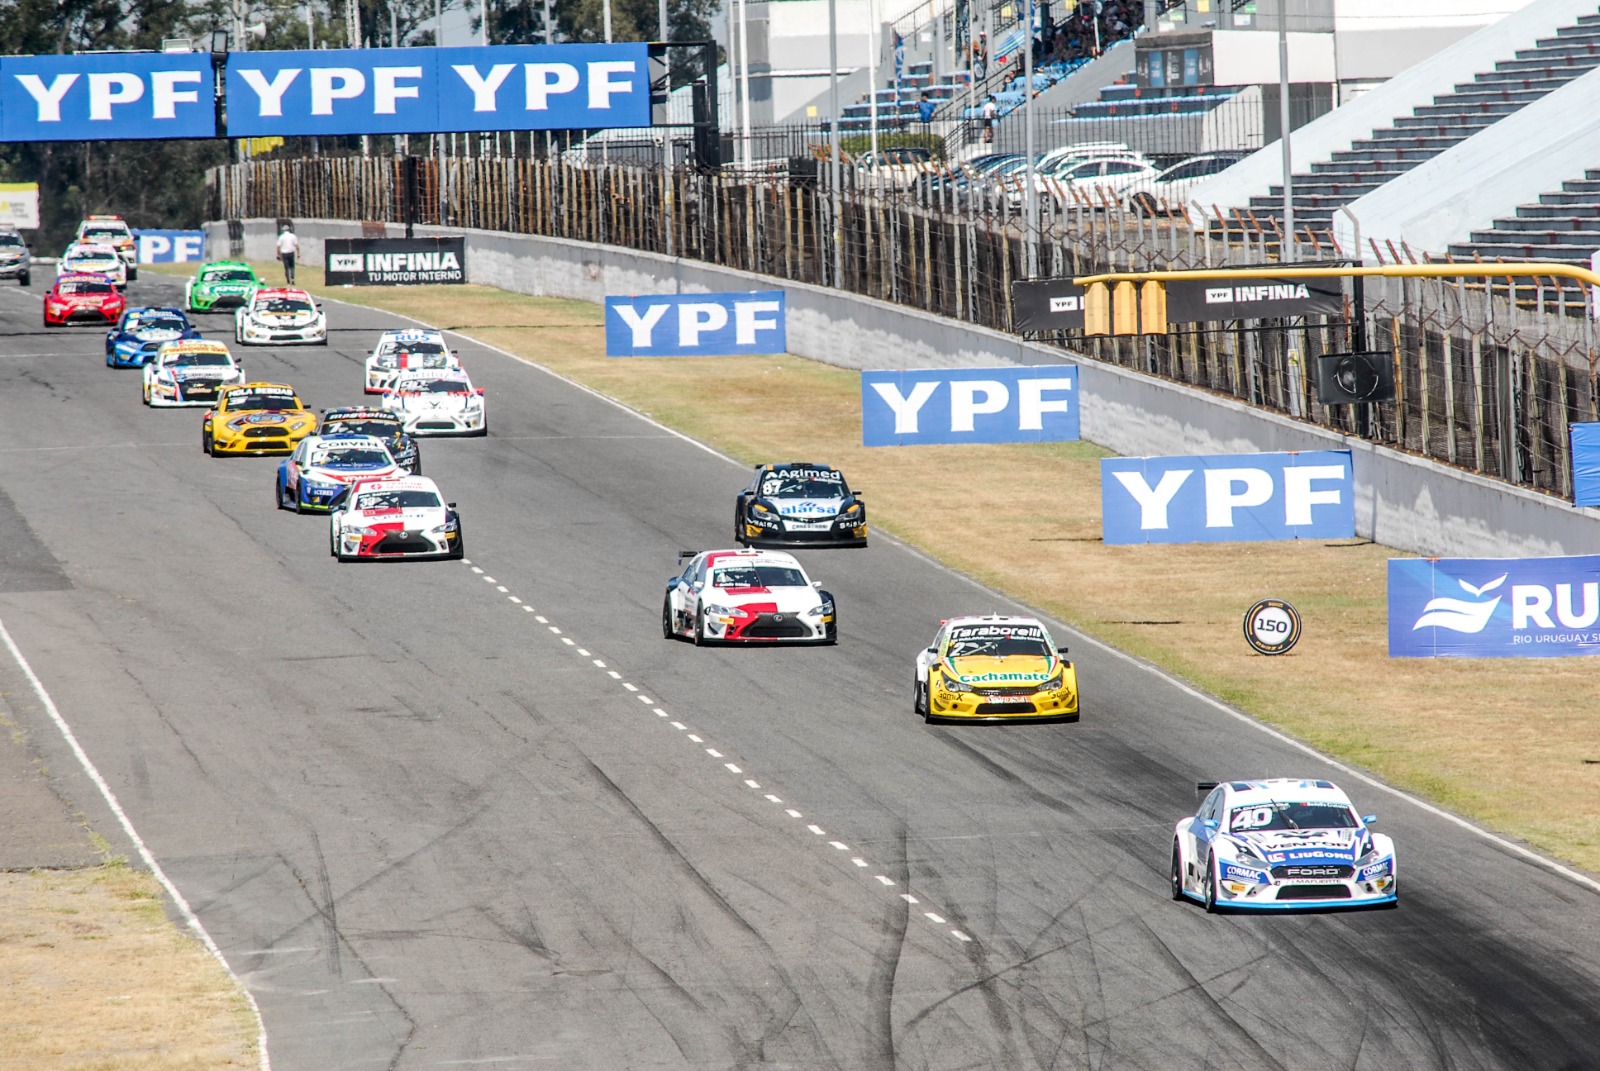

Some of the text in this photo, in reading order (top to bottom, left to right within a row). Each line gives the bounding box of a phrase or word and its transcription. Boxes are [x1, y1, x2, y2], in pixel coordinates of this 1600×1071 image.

[15, 71, 202, 122] YPF
[236, 61, 636, 117] YPF YPF
[139, 235, 202, 264] PF
[336, 252, 461, 272] YPF INFINIA
[368, 270, 462, 282] TU MOTOR INTERNO
[1235, 283, 1310, 303] INFINIA
[612, 301, 780, 348] YPF
[395, 334, 430, 342] RUS
[870, 378, 1072, 434] YPF
[316, 441, 378, 450] CORVEN
[778, 468, 841, 480] Agimed
[762, 480, 784, 495] 87
[1112, 465, 1345, 530] YPF
[780, 504, 837, 515] alarsa
[1512, 582, 1599, 629] RU
[952, 625, 1042, 639] Taraborelli
[1256, 618, 1288, 633] 150
[1513, 635, 1532, 644] RIO
[1535, 633, 1589, 643] URUGUAY
[950, 641, 966, 657] 2
[959, 672, 1050, 683] Cachamate
[1231, 807, 1273, 828] 40
[1265, 841, 1349, 850] VENTOR
[1226, 865, 1262, 880] CORMAC
[1287, 868, 1339, 876] FORD
